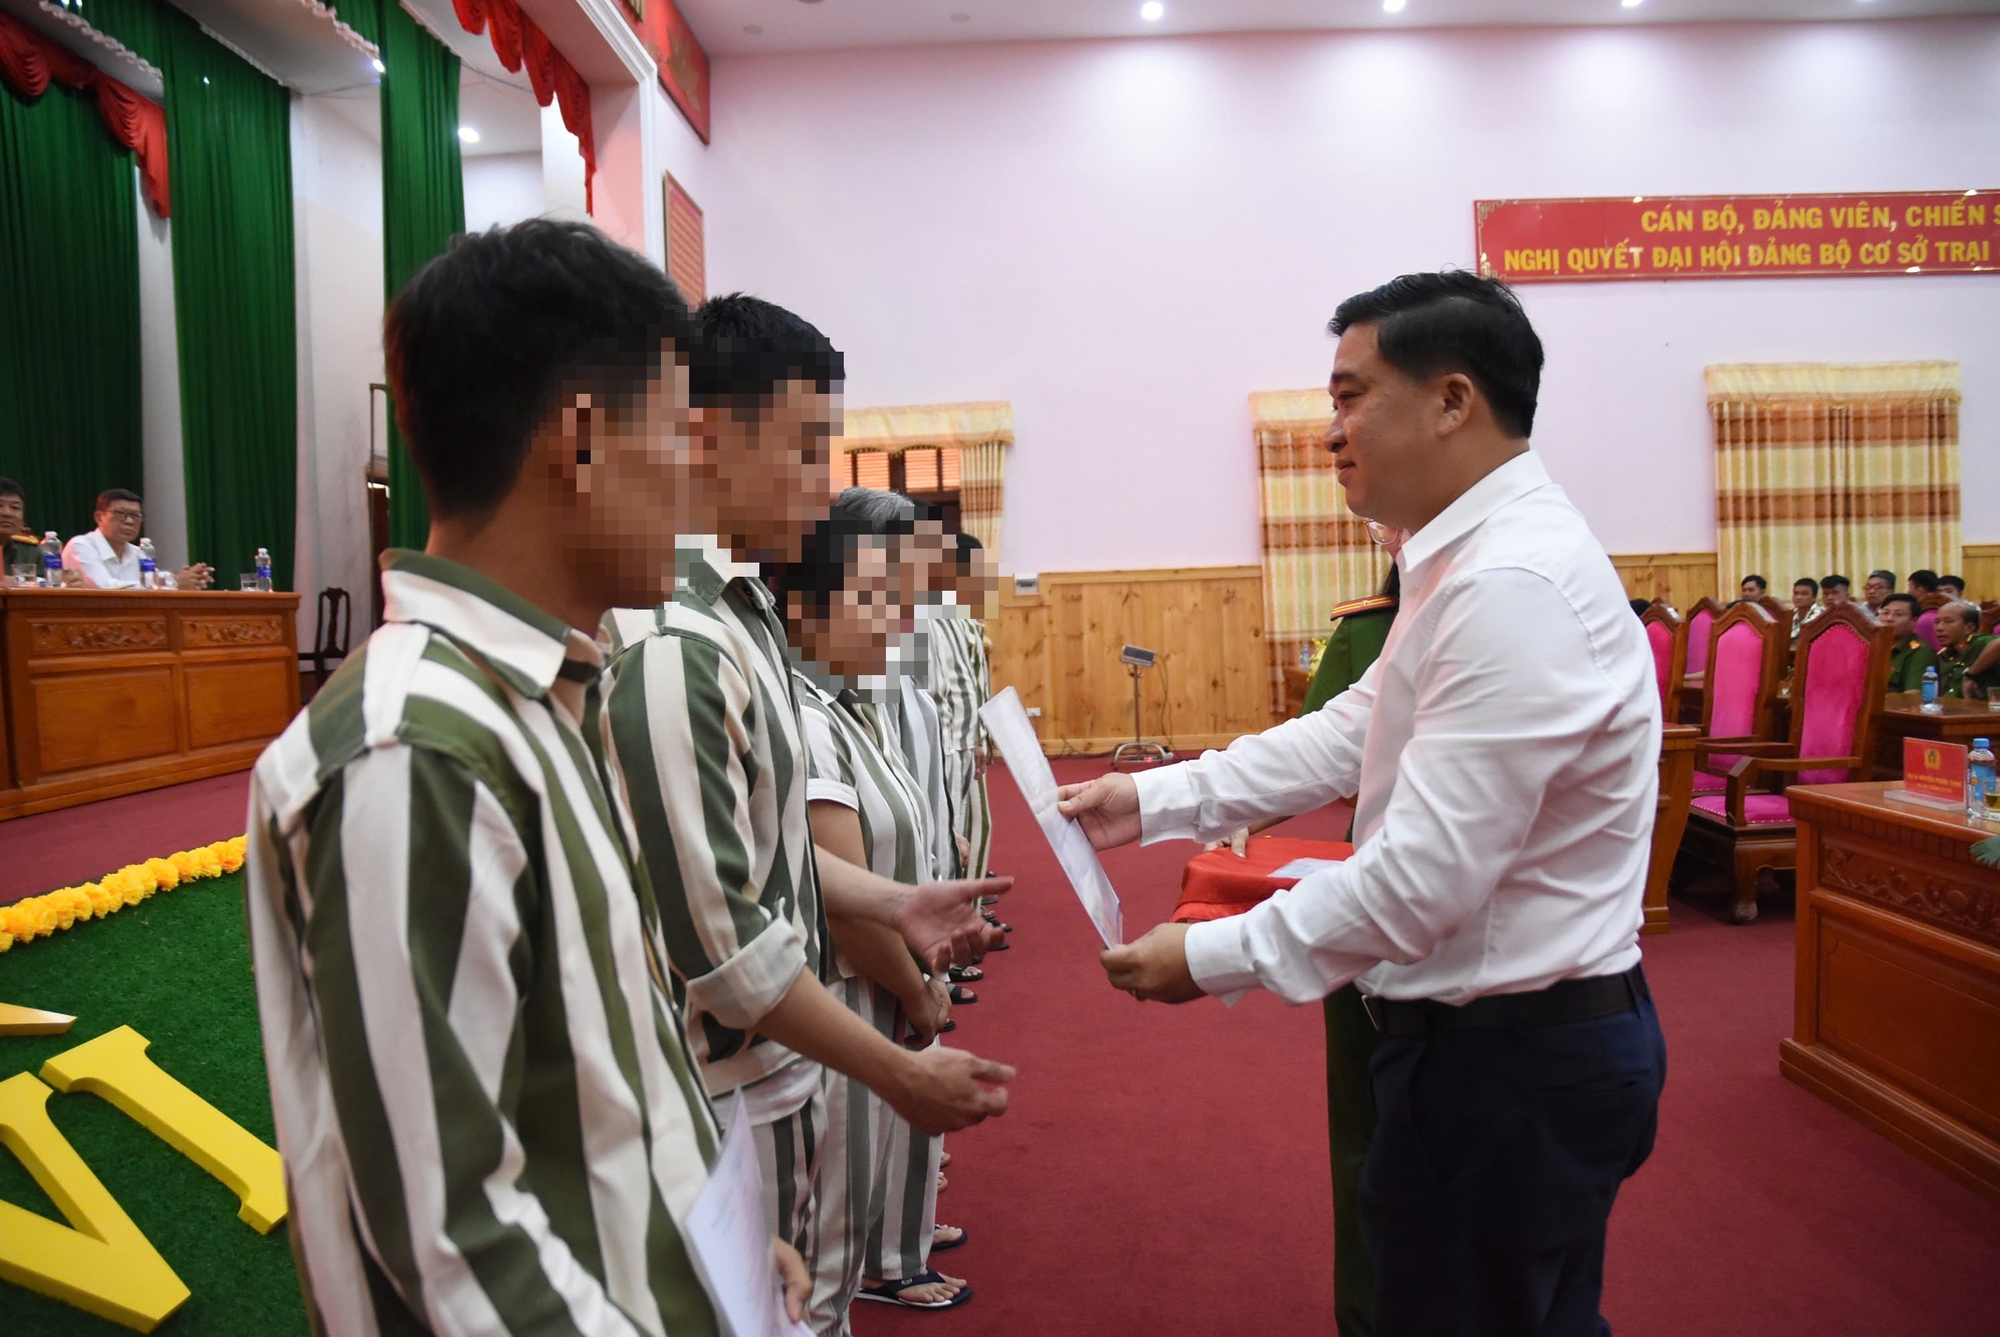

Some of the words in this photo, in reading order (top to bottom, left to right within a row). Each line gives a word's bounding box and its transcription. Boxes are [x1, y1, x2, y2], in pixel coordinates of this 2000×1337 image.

[1641, 203, 1694, 233] CÁN
[1702, 203, 1745, 235] BỘ,
[1753, 199, 1823, 230] ĐẢNG
[1829, 200, 1897, 232] VIÊN,
[1905, 196, 1986, 227] CHIẾN
[1504, 248, 1560, 275] NGHỊ
[1567, 237, 1644, 273] QUYẾT
[1651, 246, 1693, 272] ĐẠI
[1700, 239, 1741, 271] HỘI
[1747, 236, 1812, 267] ĐẢNG
[1819, 238, 1852, 269] BỘ
[1859, 239, 1892, 265] CƠ
[1897, 233, 1929, 263] SỞ
[1935, 239, 1990, 267] TRẠI
